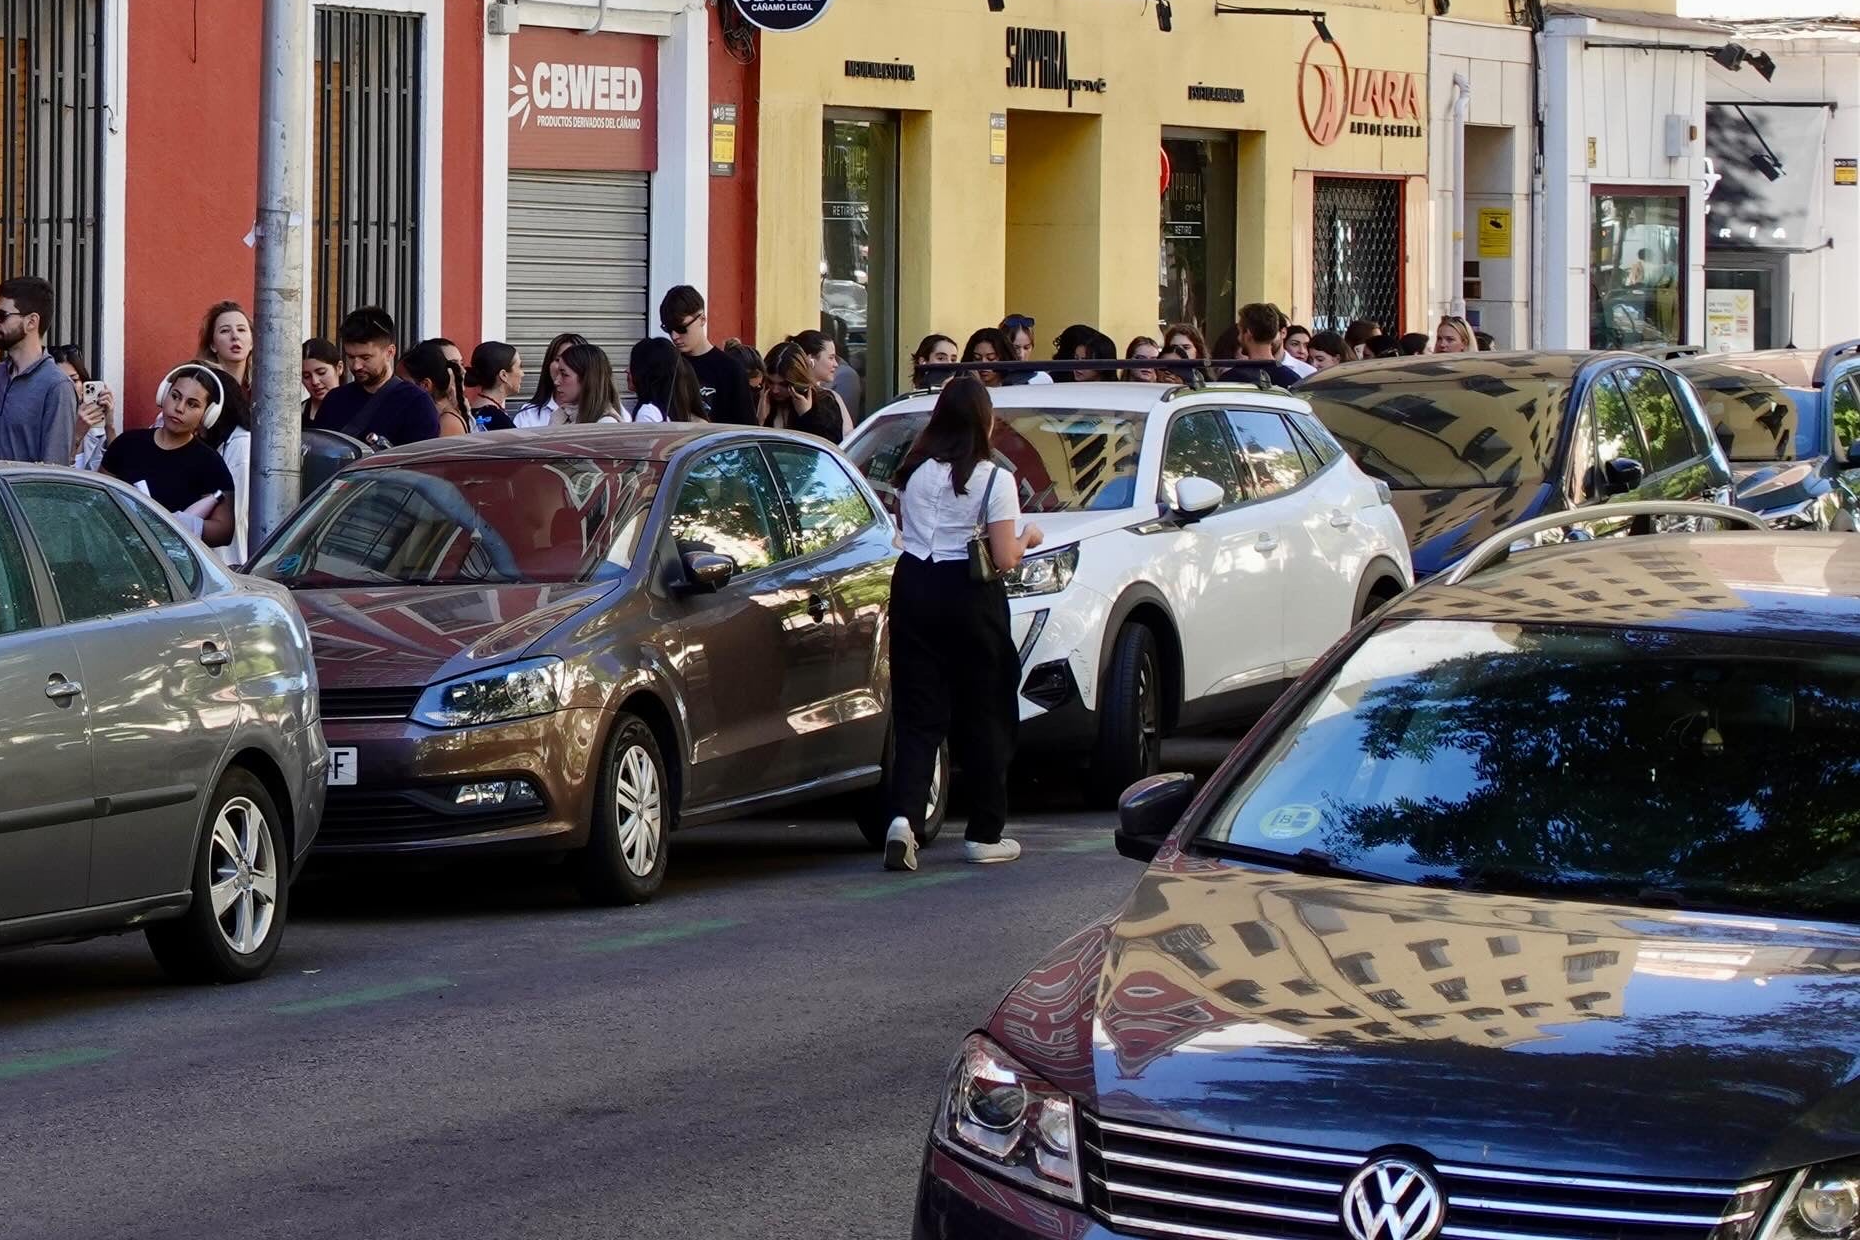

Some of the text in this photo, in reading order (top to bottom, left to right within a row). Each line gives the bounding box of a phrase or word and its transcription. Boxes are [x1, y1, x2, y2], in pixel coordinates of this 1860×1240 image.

[751, 2, 813, 12] CÁÑAMO LEGAL
[532, 61, 643, 112] CBWEED
[1349, 67, 1422, 120] LARA
[536, 115, 641, 130] PRODUCTOS DERIVADOS DEL CÁÑAMO
[1349, 121, 1423, 138] AUTOESCUELA
